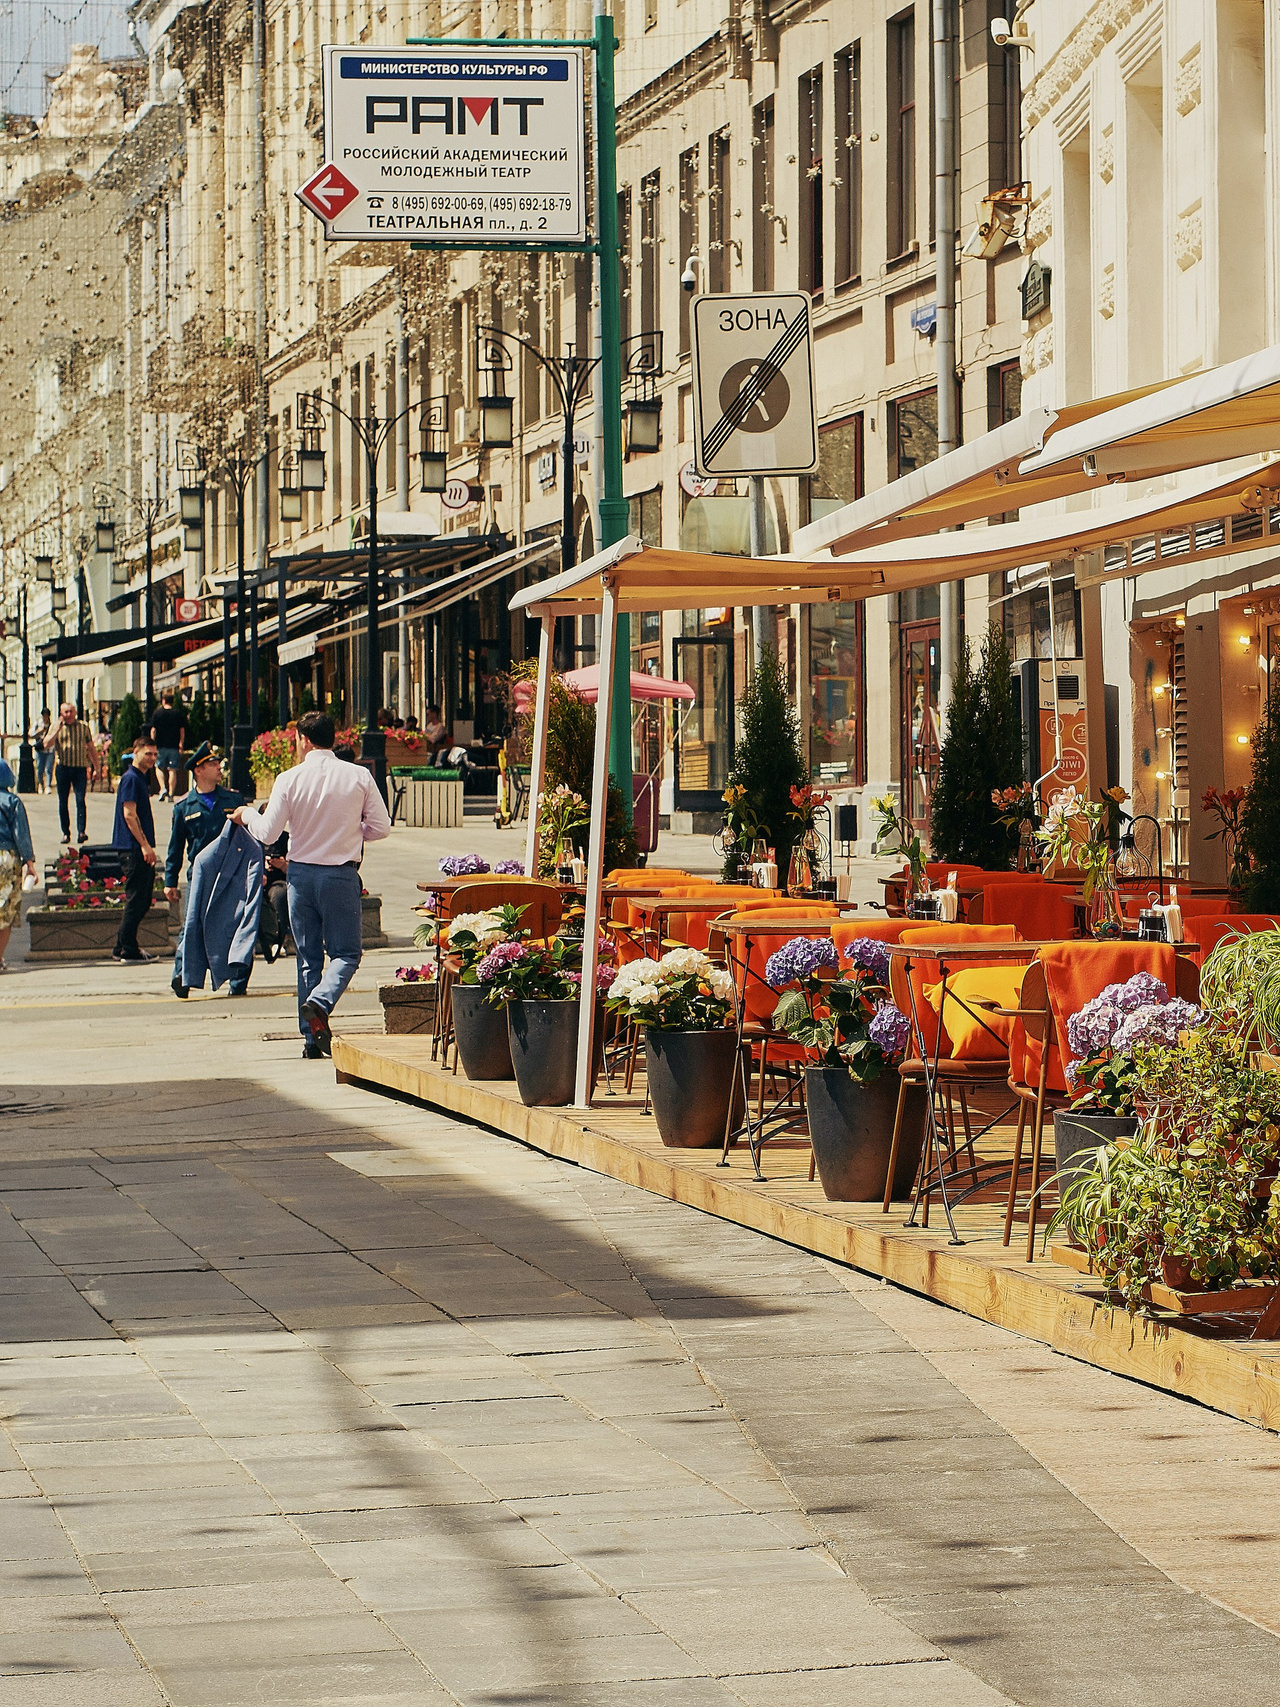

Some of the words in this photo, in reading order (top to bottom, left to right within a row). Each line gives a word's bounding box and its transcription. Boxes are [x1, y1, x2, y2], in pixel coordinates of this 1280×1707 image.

[361, 62, 459, 76] МИНИСТЕРСТВО
[461, 64, 527, 76] КУЛЬТУРЫ
[529, 65, 548, 76] РФ
[365, 95, 544, 136] РАМТ
[343, 147, 440, 161] РОССИЙСКИЙ
[443, 147, 568, 162] АКАДЕМИЧЕСКИЙ
[381, 164, 487, 179] МОЛОДЕЖНЫЙ
[491, 166, 532, 178] ТЕАТР
[392, 197, 399, 210] 8
[401, 196, 429, 211] (495)
[431, 197, 487, 213] 692-00-69,
[489, 197, 517, 212] (495)
[518, 198, 572, 212] 692-18-79
[367, 215, 484, 230] ТЕАТРАЛЬНАЯ
[489, 219, 516, 231] пл.,
[519, 220, 533, 232] д.
[538, 217, 547, 230] 2
[719, 308, 789, 332] ЗОНА
[1060, 760, 1081, 770] QIWI
